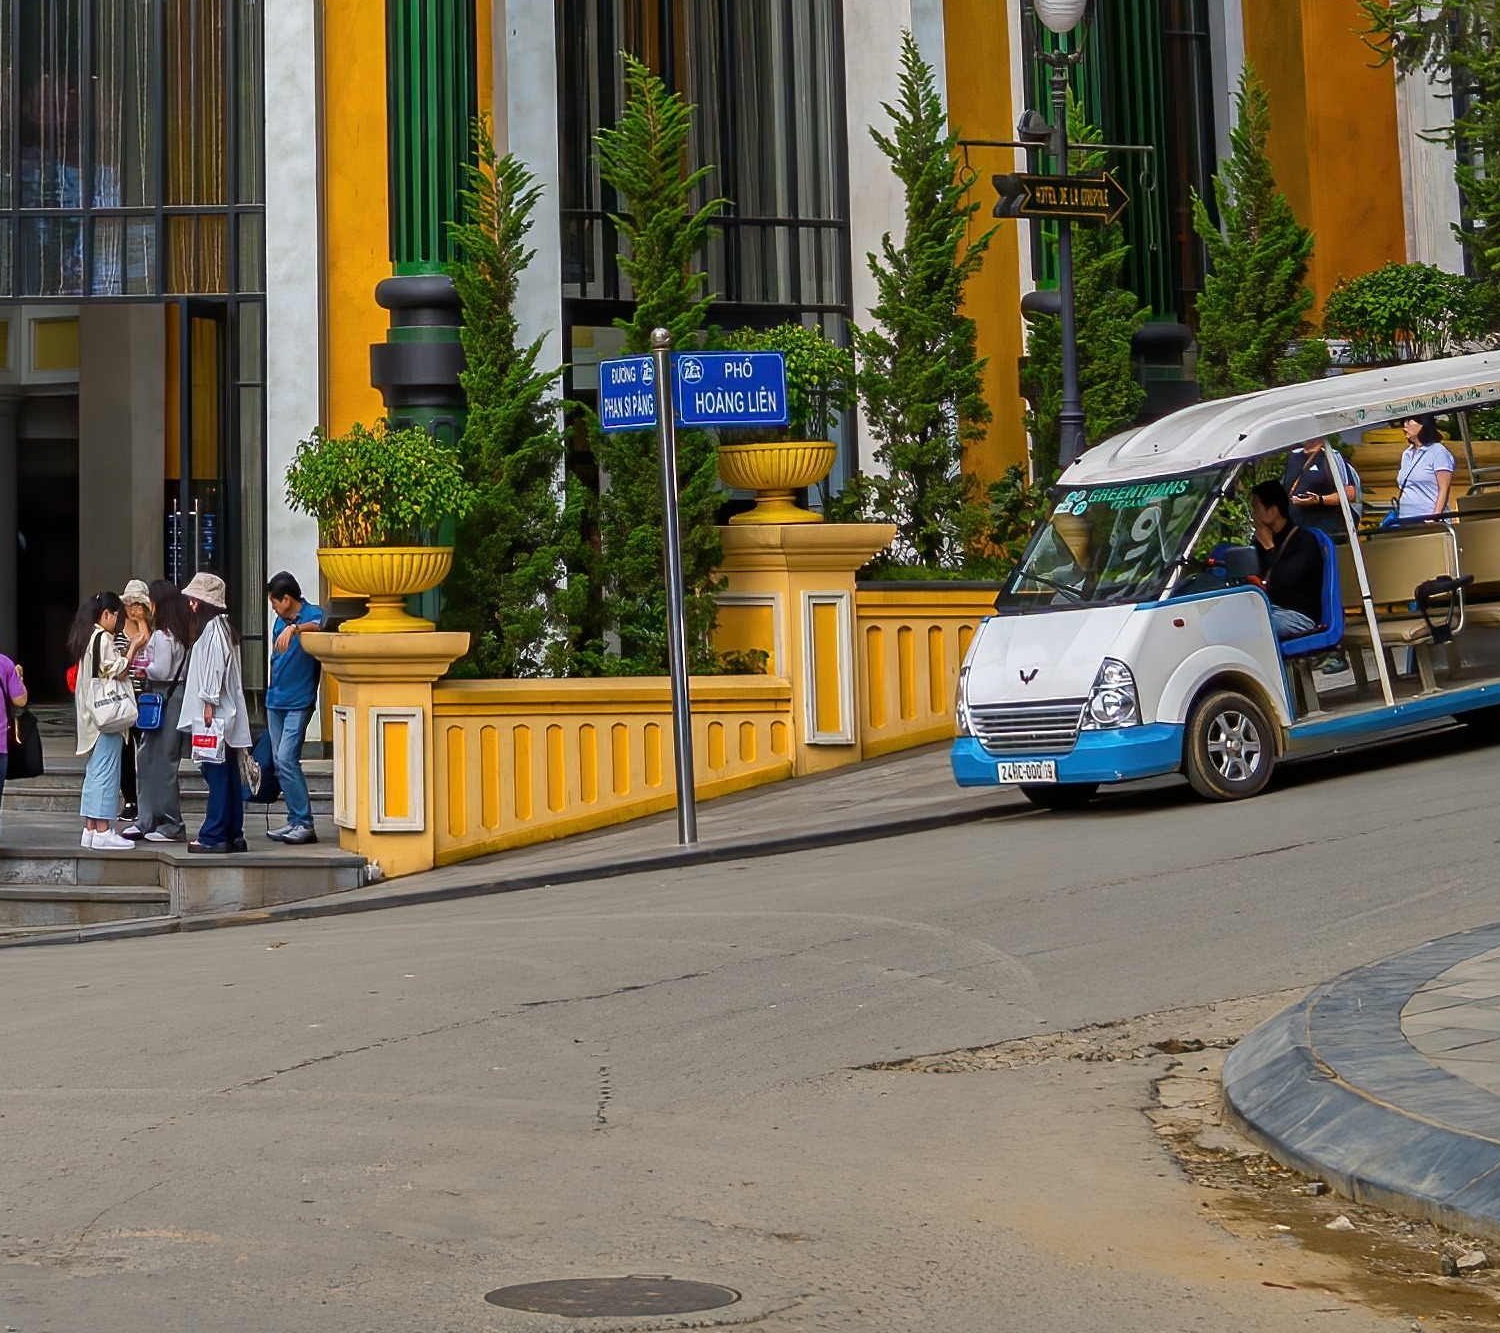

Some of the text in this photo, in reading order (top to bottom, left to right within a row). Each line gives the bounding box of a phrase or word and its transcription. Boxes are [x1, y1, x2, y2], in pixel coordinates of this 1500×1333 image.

[695, 385, 777, 414] HOÀNG LIÊN
[1088, 479, 1190, 503] GREENTRANS
